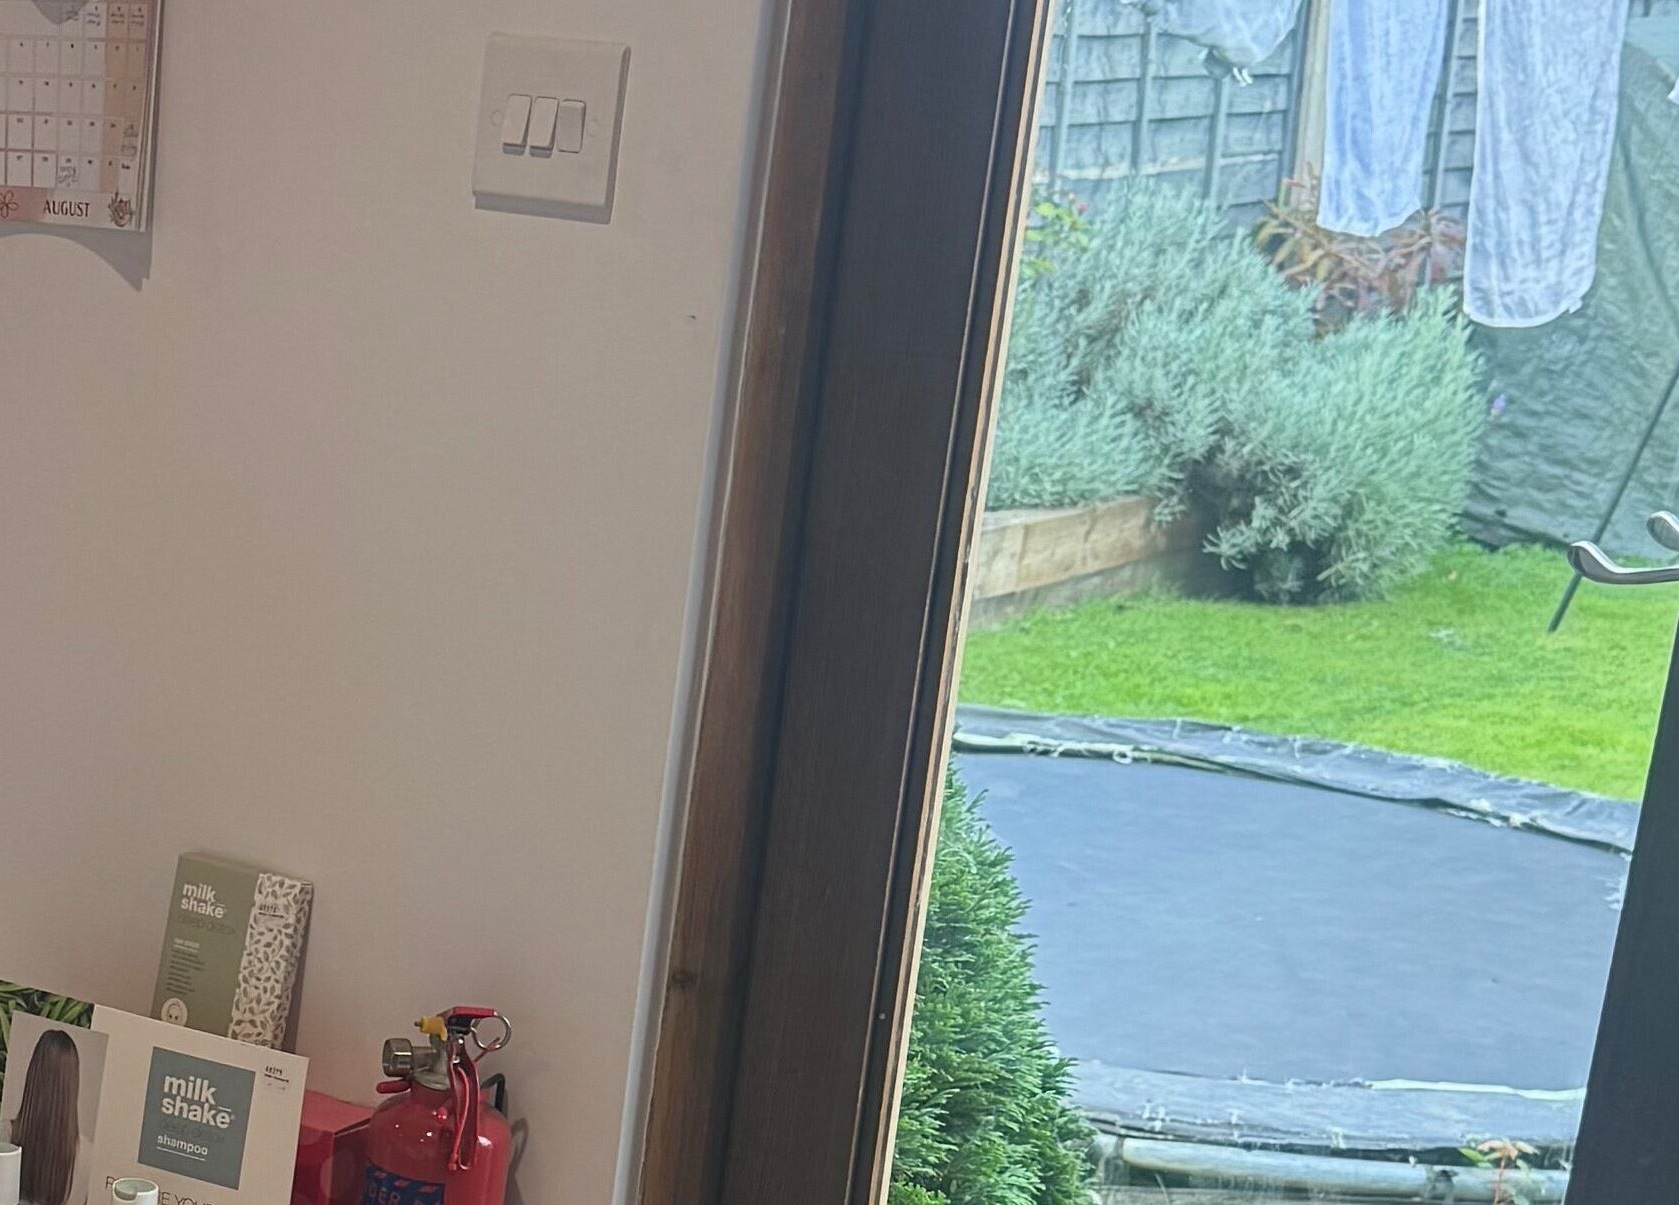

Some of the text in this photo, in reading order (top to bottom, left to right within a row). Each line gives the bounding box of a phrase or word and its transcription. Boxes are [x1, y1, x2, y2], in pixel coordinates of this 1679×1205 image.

[43, 199, 90, 218] AUGUST
[181, 882, 217, 903] milk
[180, 898, 225, 919] shake
[163, 1074, 217, 1106] milk
[161, 1096, 232, 1129] shake
[157, 1134, 208, 1156] shampoo
